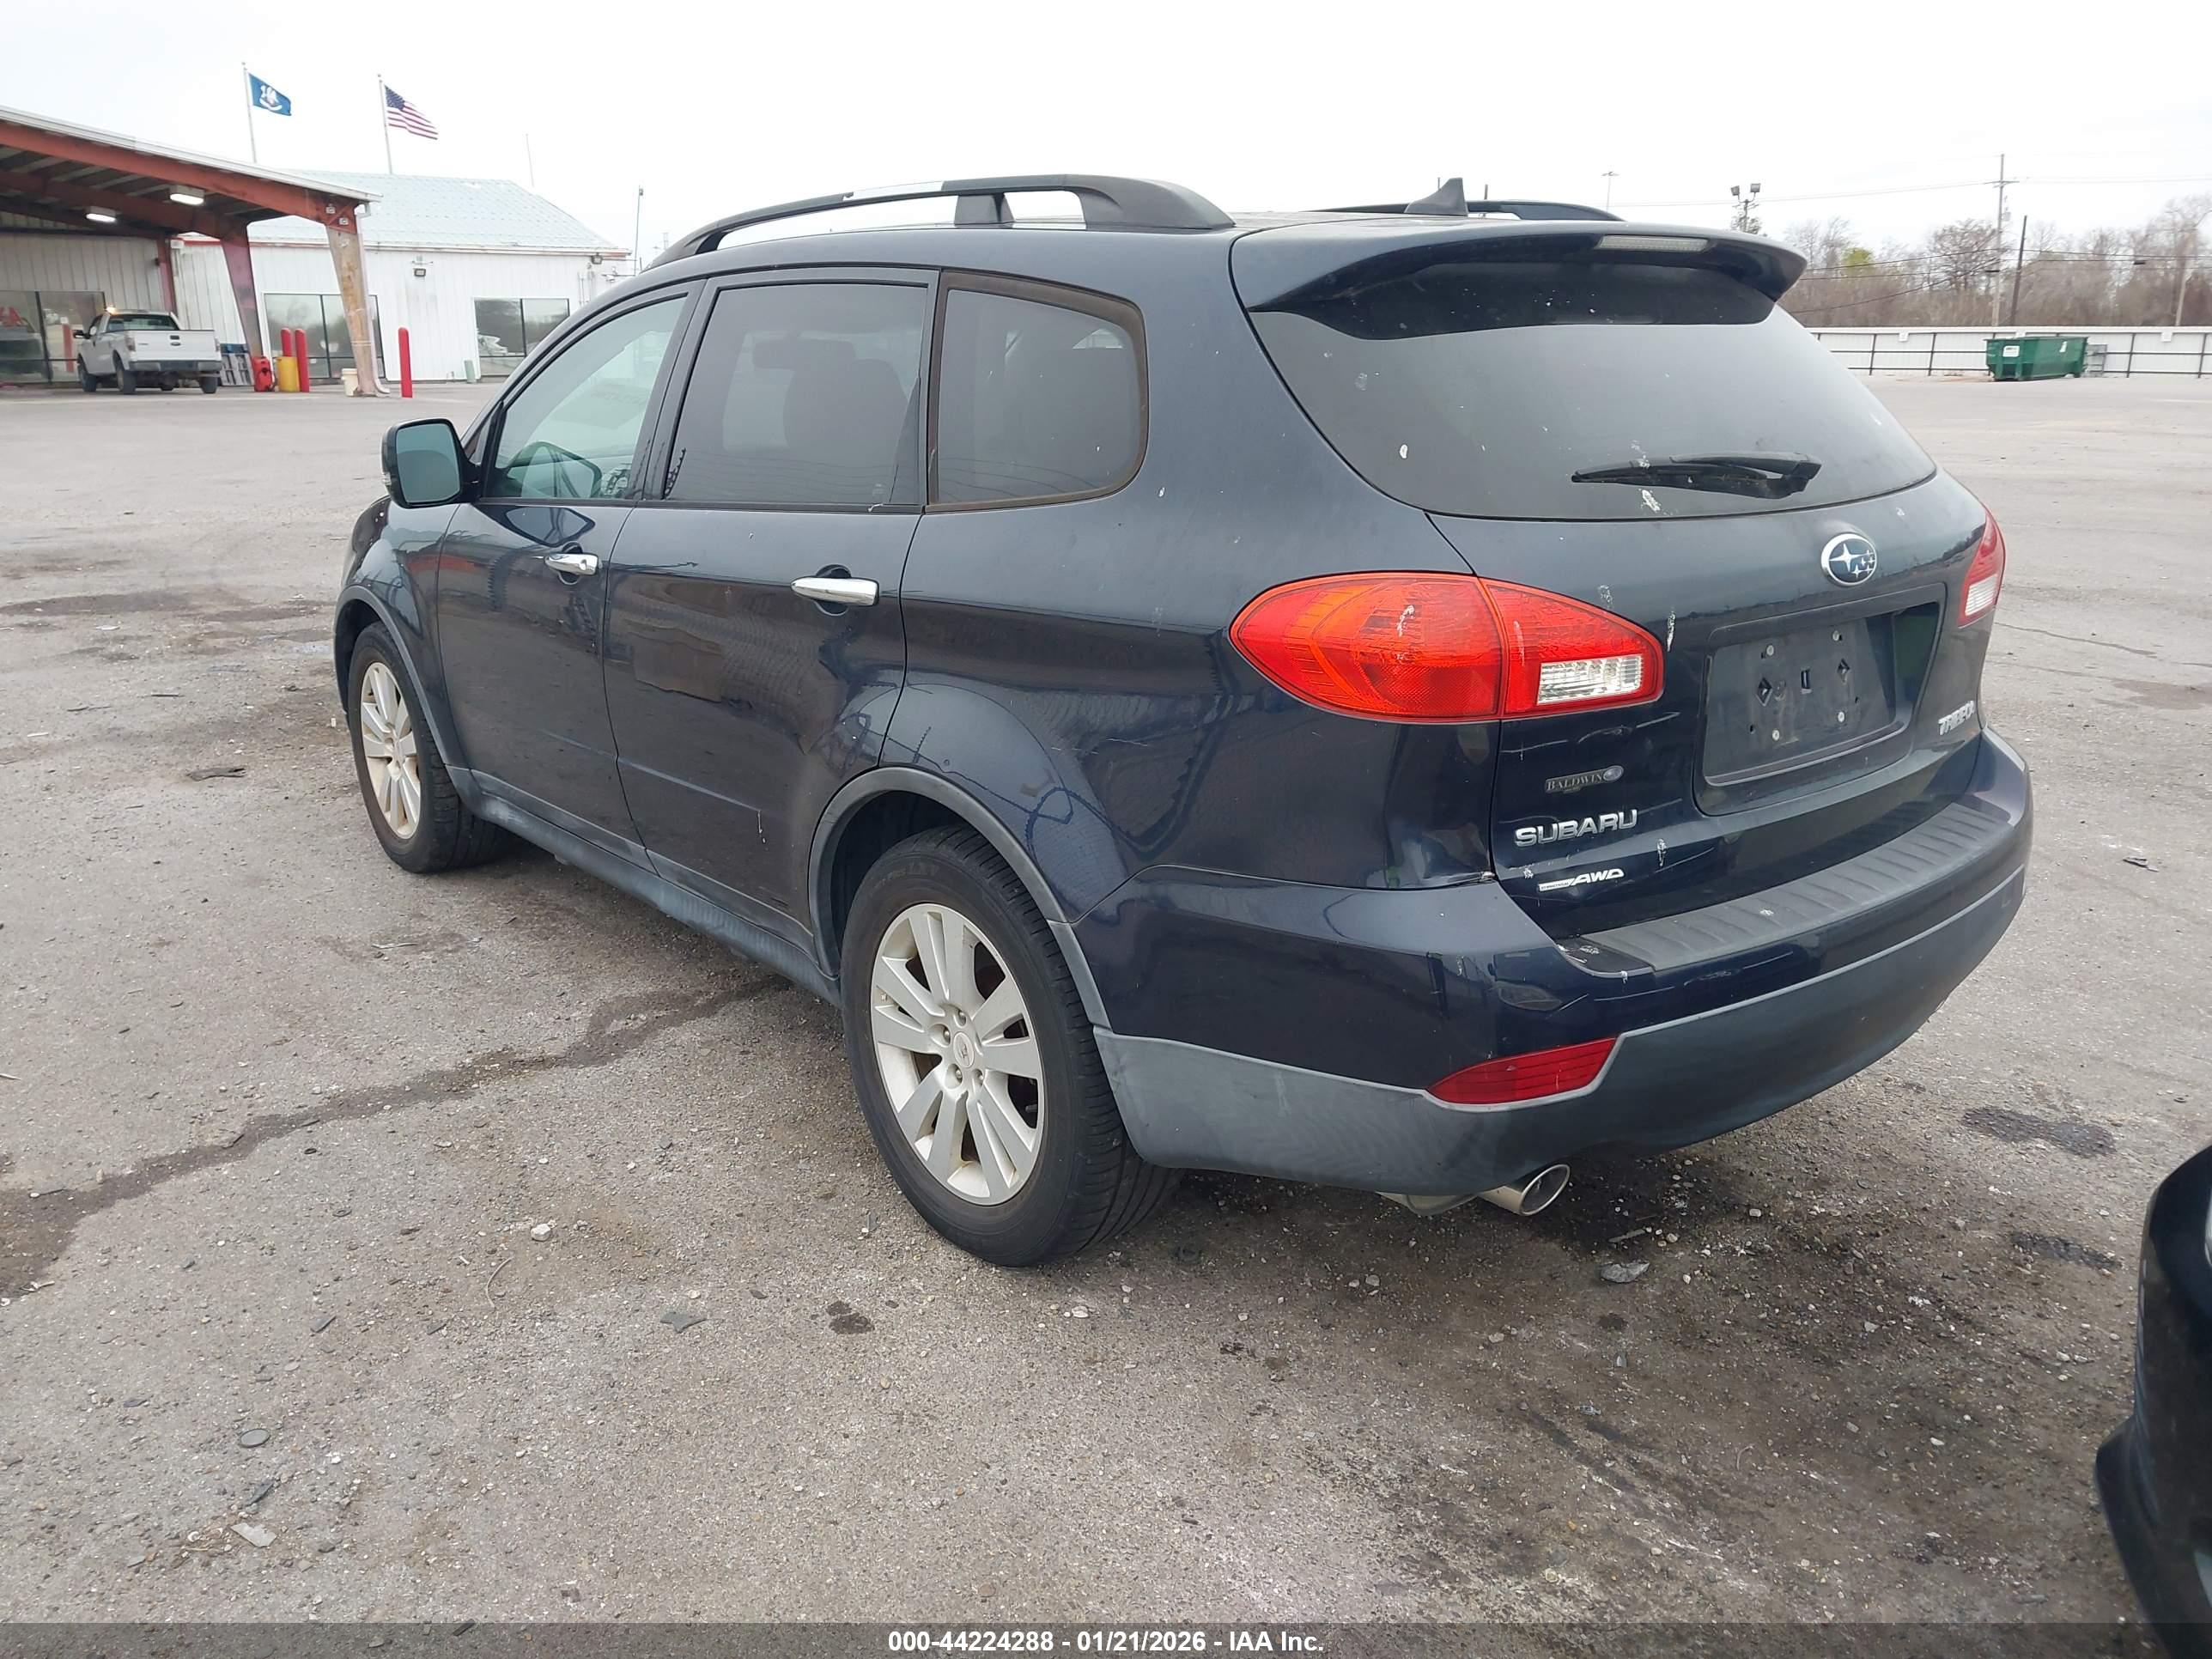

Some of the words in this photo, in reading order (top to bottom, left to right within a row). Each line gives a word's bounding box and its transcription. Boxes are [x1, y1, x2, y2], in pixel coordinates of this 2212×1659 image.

[1547, 774, 1602, 792] BALDWIN
[1515, 809, 1638, 848] SUBARU
[1571, 868, 1625, 886] AWD
